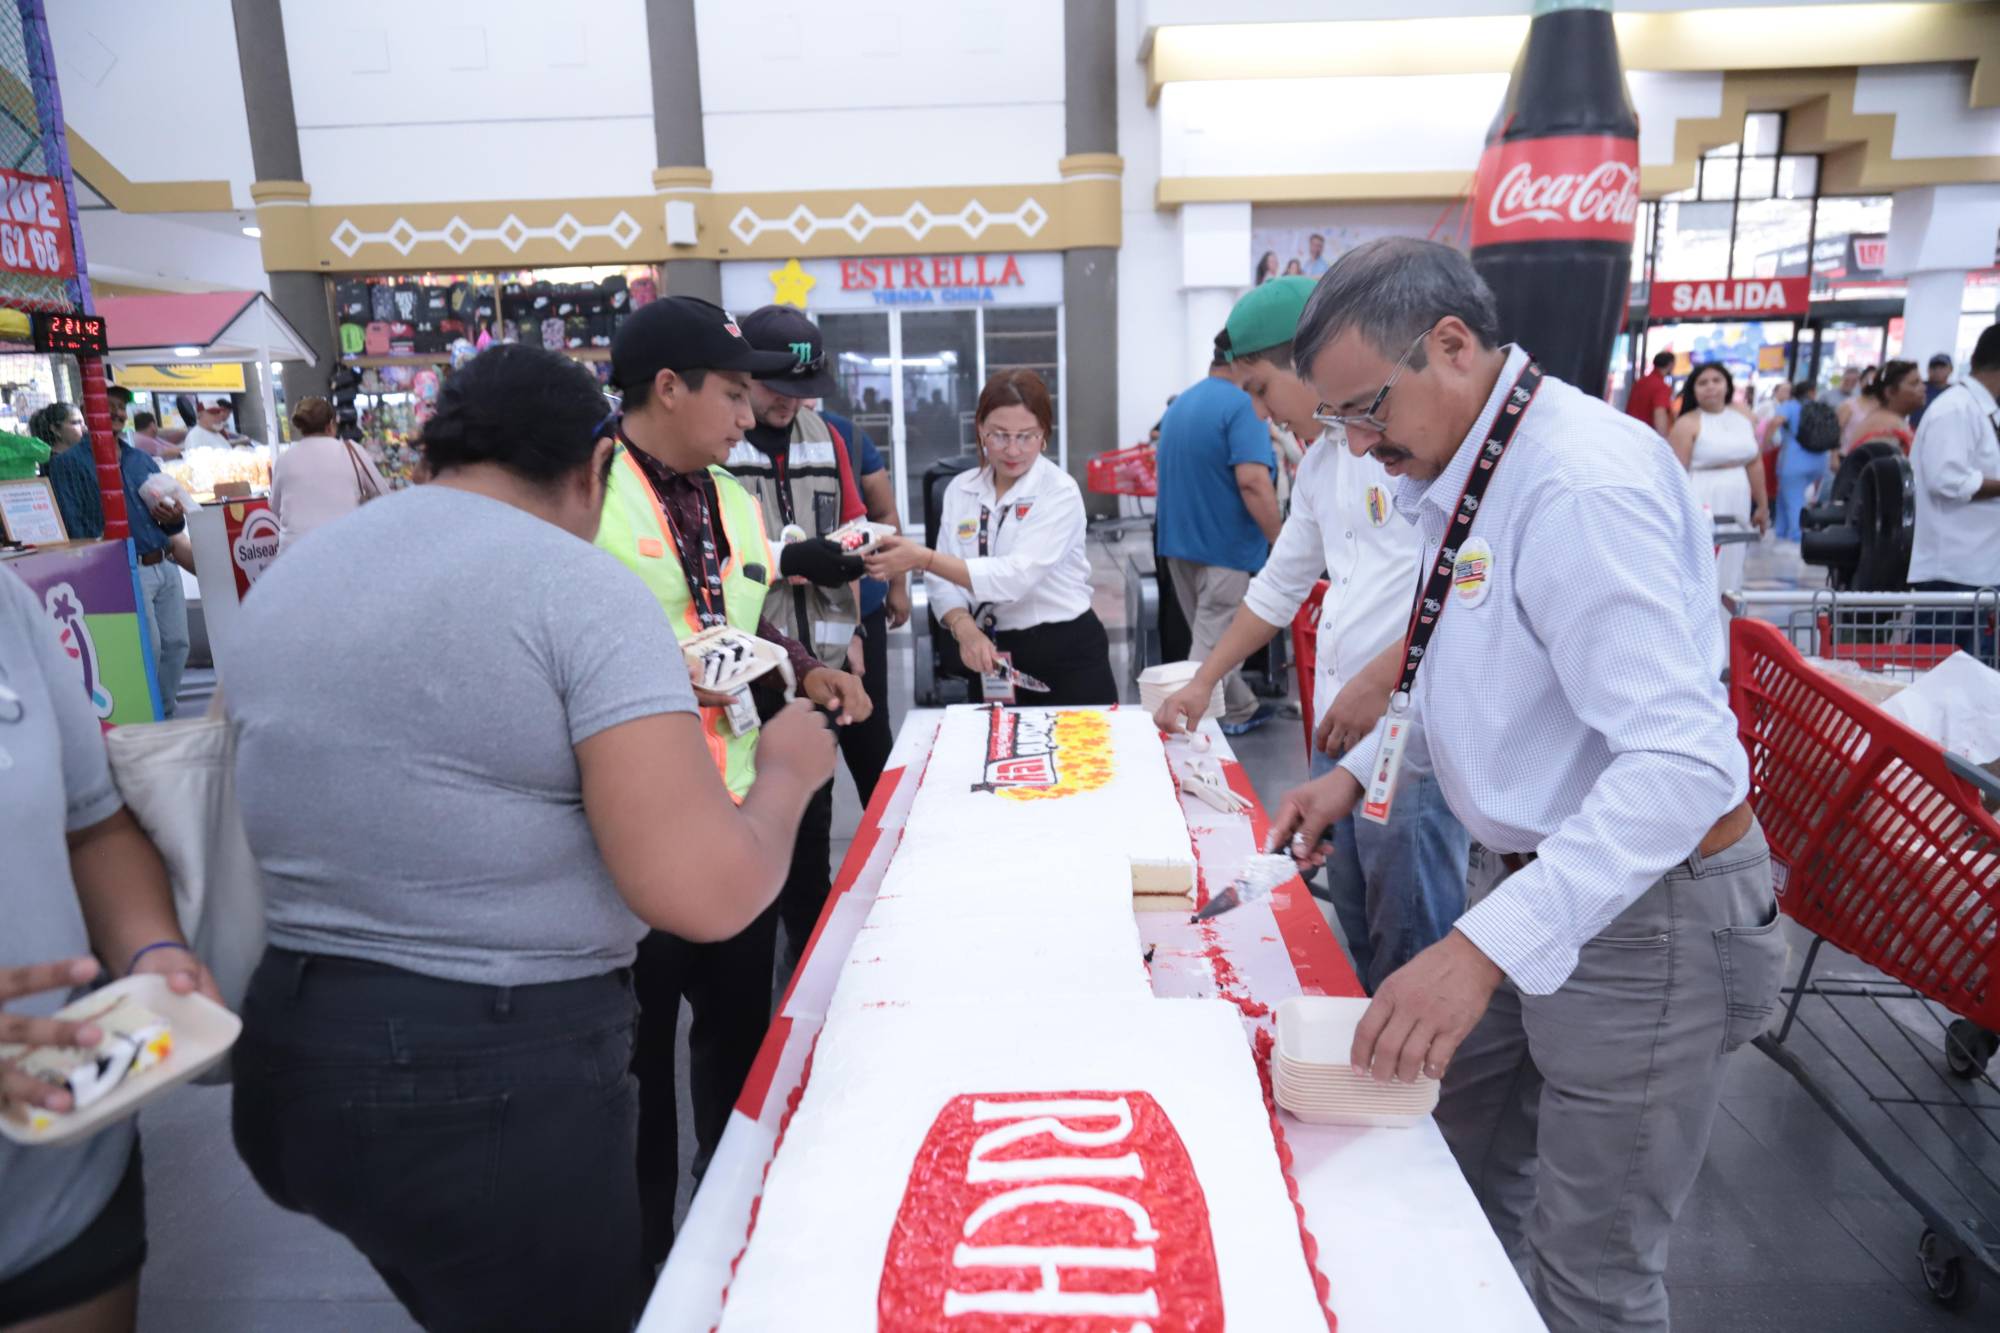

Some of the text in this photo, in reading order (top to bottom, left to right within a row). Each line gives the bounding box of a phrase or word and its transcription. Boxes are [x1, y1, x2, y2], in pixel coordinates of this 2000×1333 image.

[1489, 160, 1638, 226] Coca-Cola
[0, 223, 60, 272] 62 66
[839, 253, 1025, 292] ESTRELLA
[872, 287, 995, 304] TIENDA CHINA
[1672, 281, 1787, 312] SALIDA
[944, 1096, 1160, 1333] RICH
